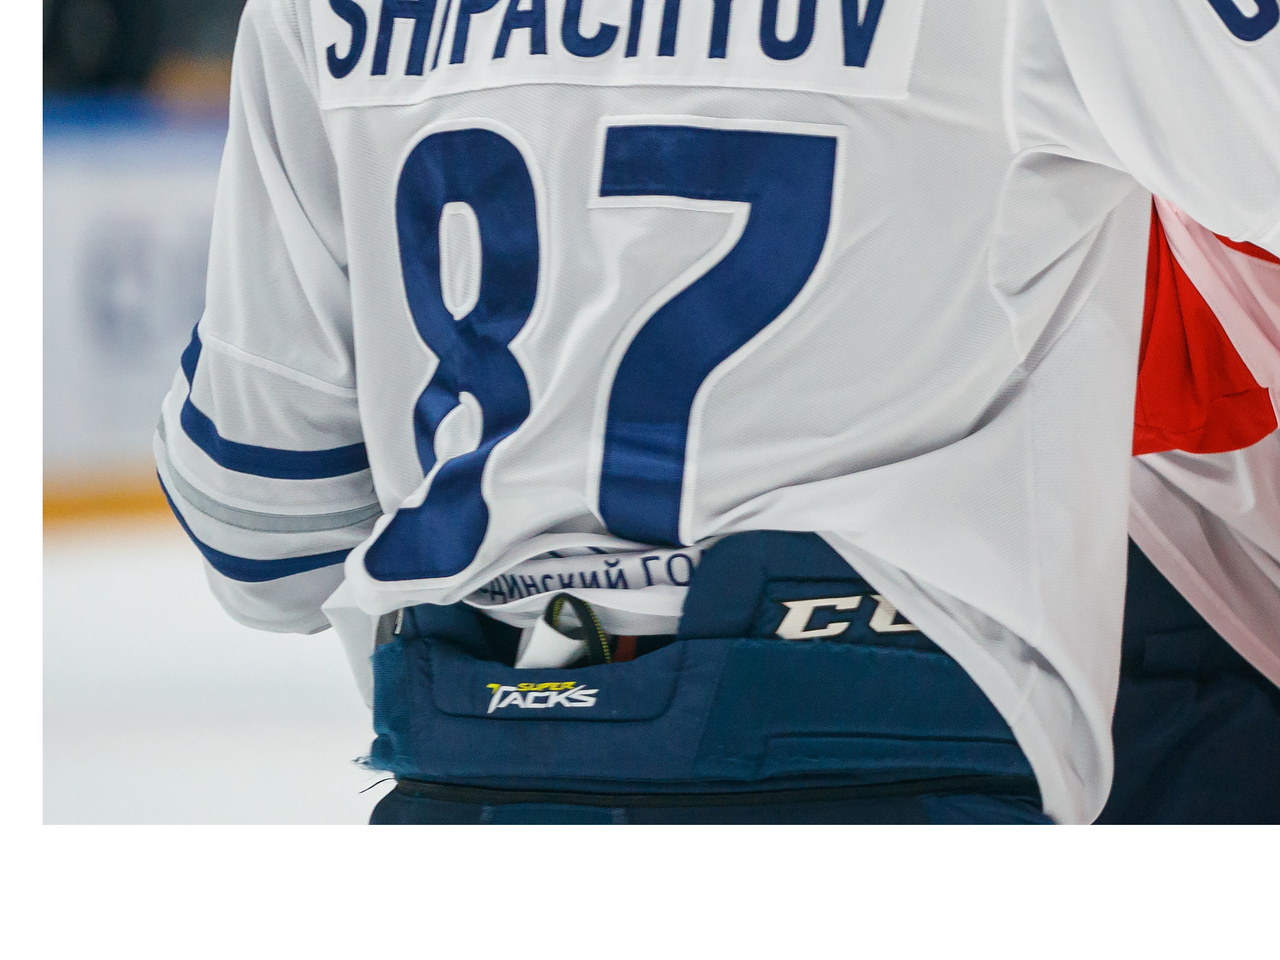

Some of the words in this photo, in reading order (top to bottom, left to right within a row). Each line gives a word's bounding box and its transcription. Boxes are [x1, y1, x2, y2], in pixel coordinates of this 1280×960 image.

[363, 122, 842, 582] 87
[640, 552, 694, 587] ГО
[485, 682, 600, 715] TACKS
[517, 680, 578, 692] SUPER
